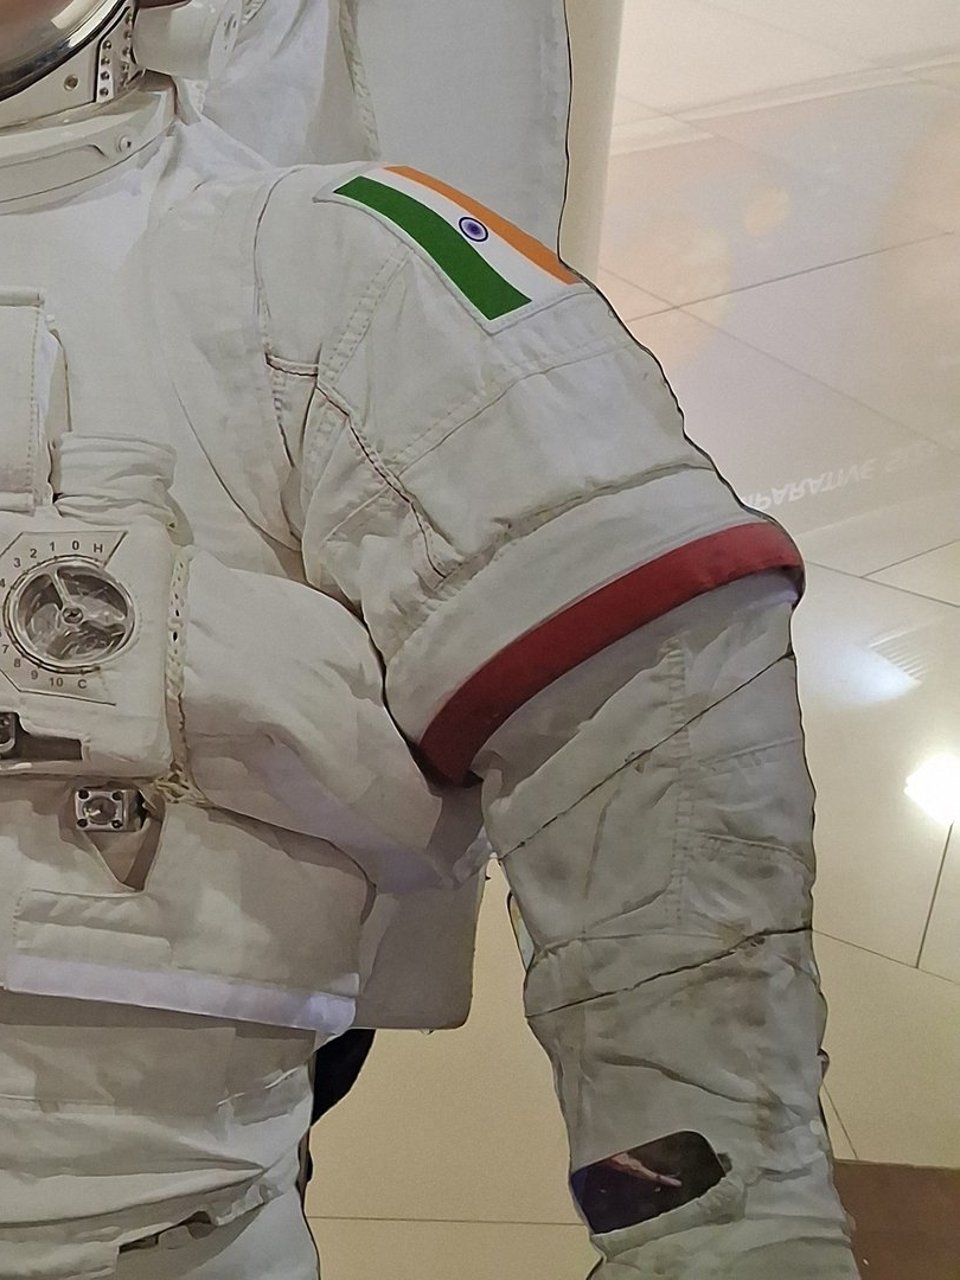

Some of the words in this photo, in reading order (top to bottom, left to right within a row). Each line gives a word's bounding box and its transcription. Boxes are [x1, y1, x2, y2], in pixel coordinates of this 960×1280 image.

[94, 544, 102, 552] H
[30, 549, 37, 558] 2
[14, 558, 20, 568] 3
[3, 644, 9, 653] 7
[13, 658, 21, 668] 8
[30, 670, 38, 680] 9
[50, 678, 63, 686] 10
[78, 679, 86, 689] C
